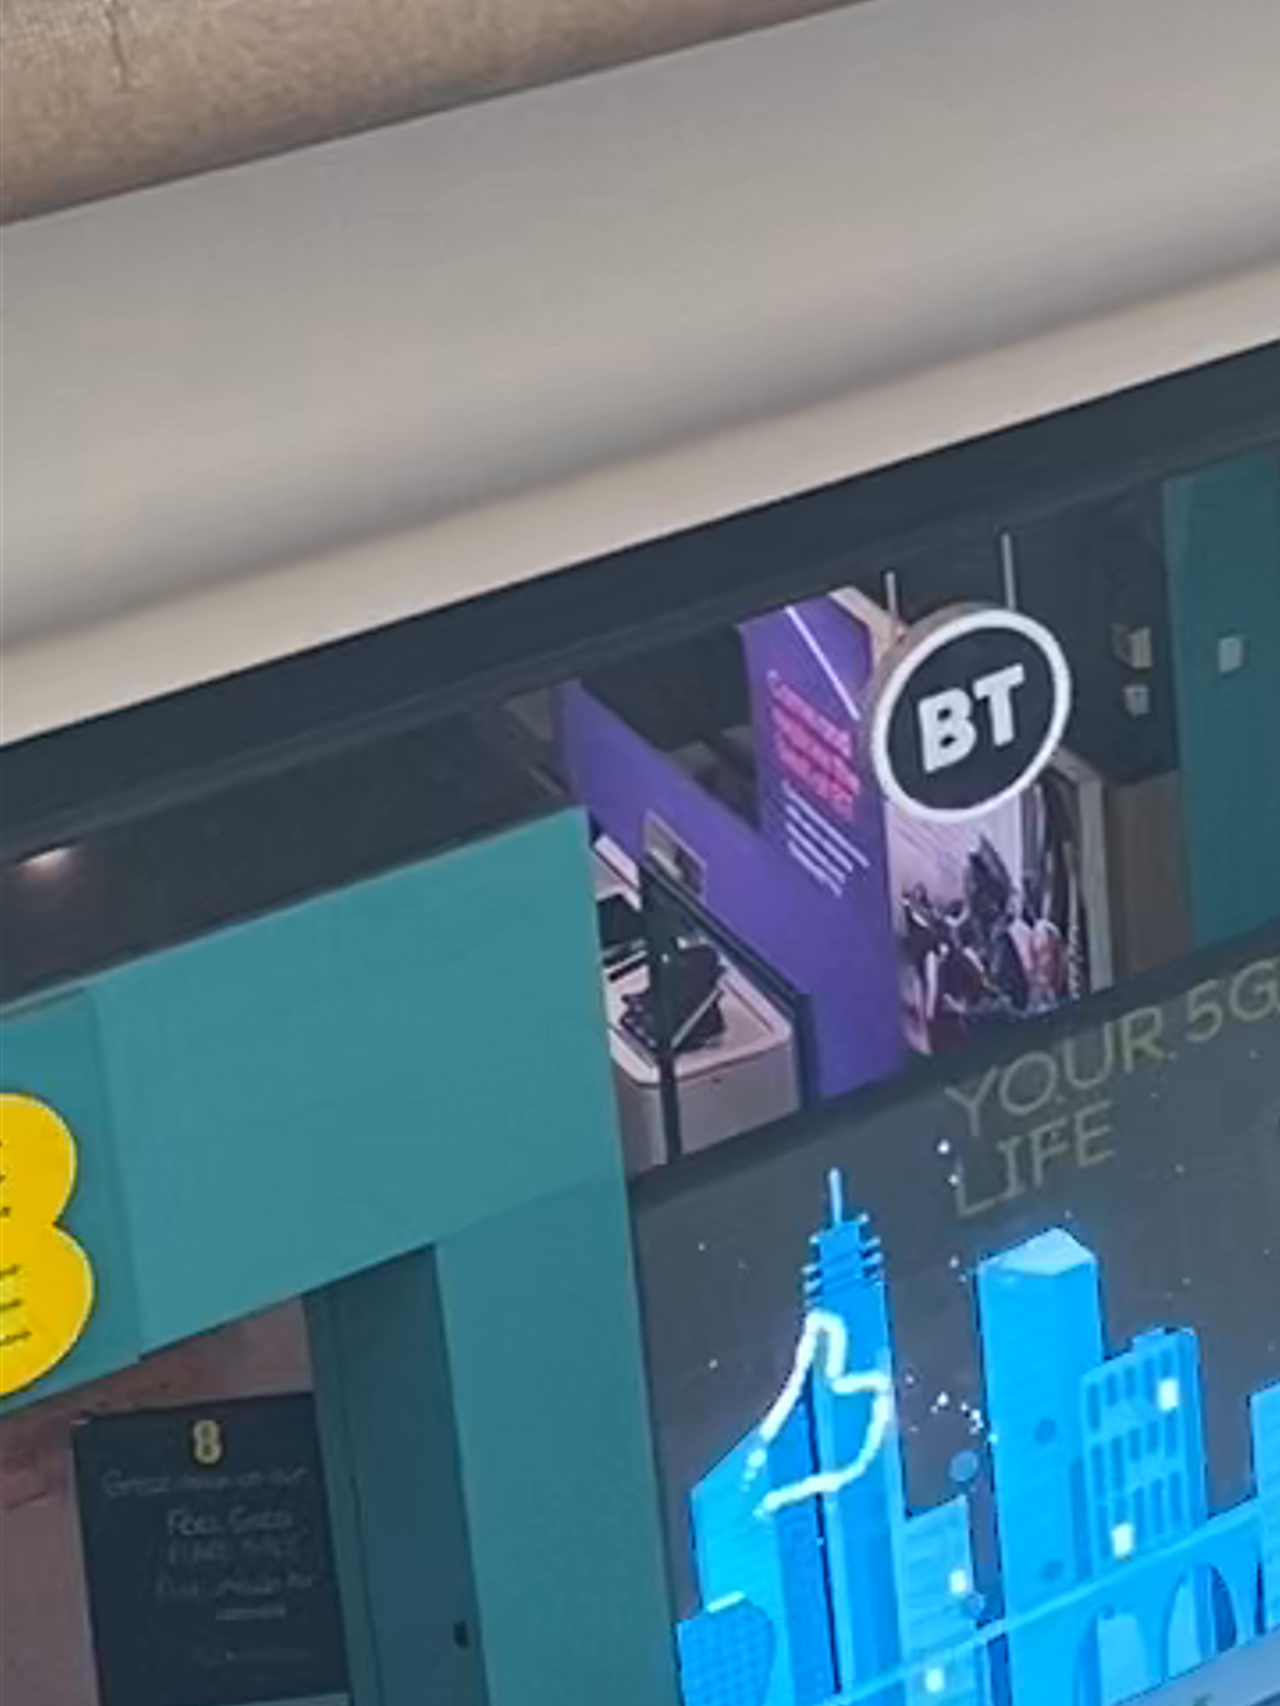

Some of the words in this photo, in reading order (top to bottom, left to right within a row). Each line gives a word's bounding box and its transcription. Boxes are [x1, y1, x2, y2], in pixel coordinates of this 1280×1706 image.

[916, 662, 1028, 774] BT
[943, 1006, 1167, 1138] YOUR
[954, 1099, 1116, 1219] LIFE
